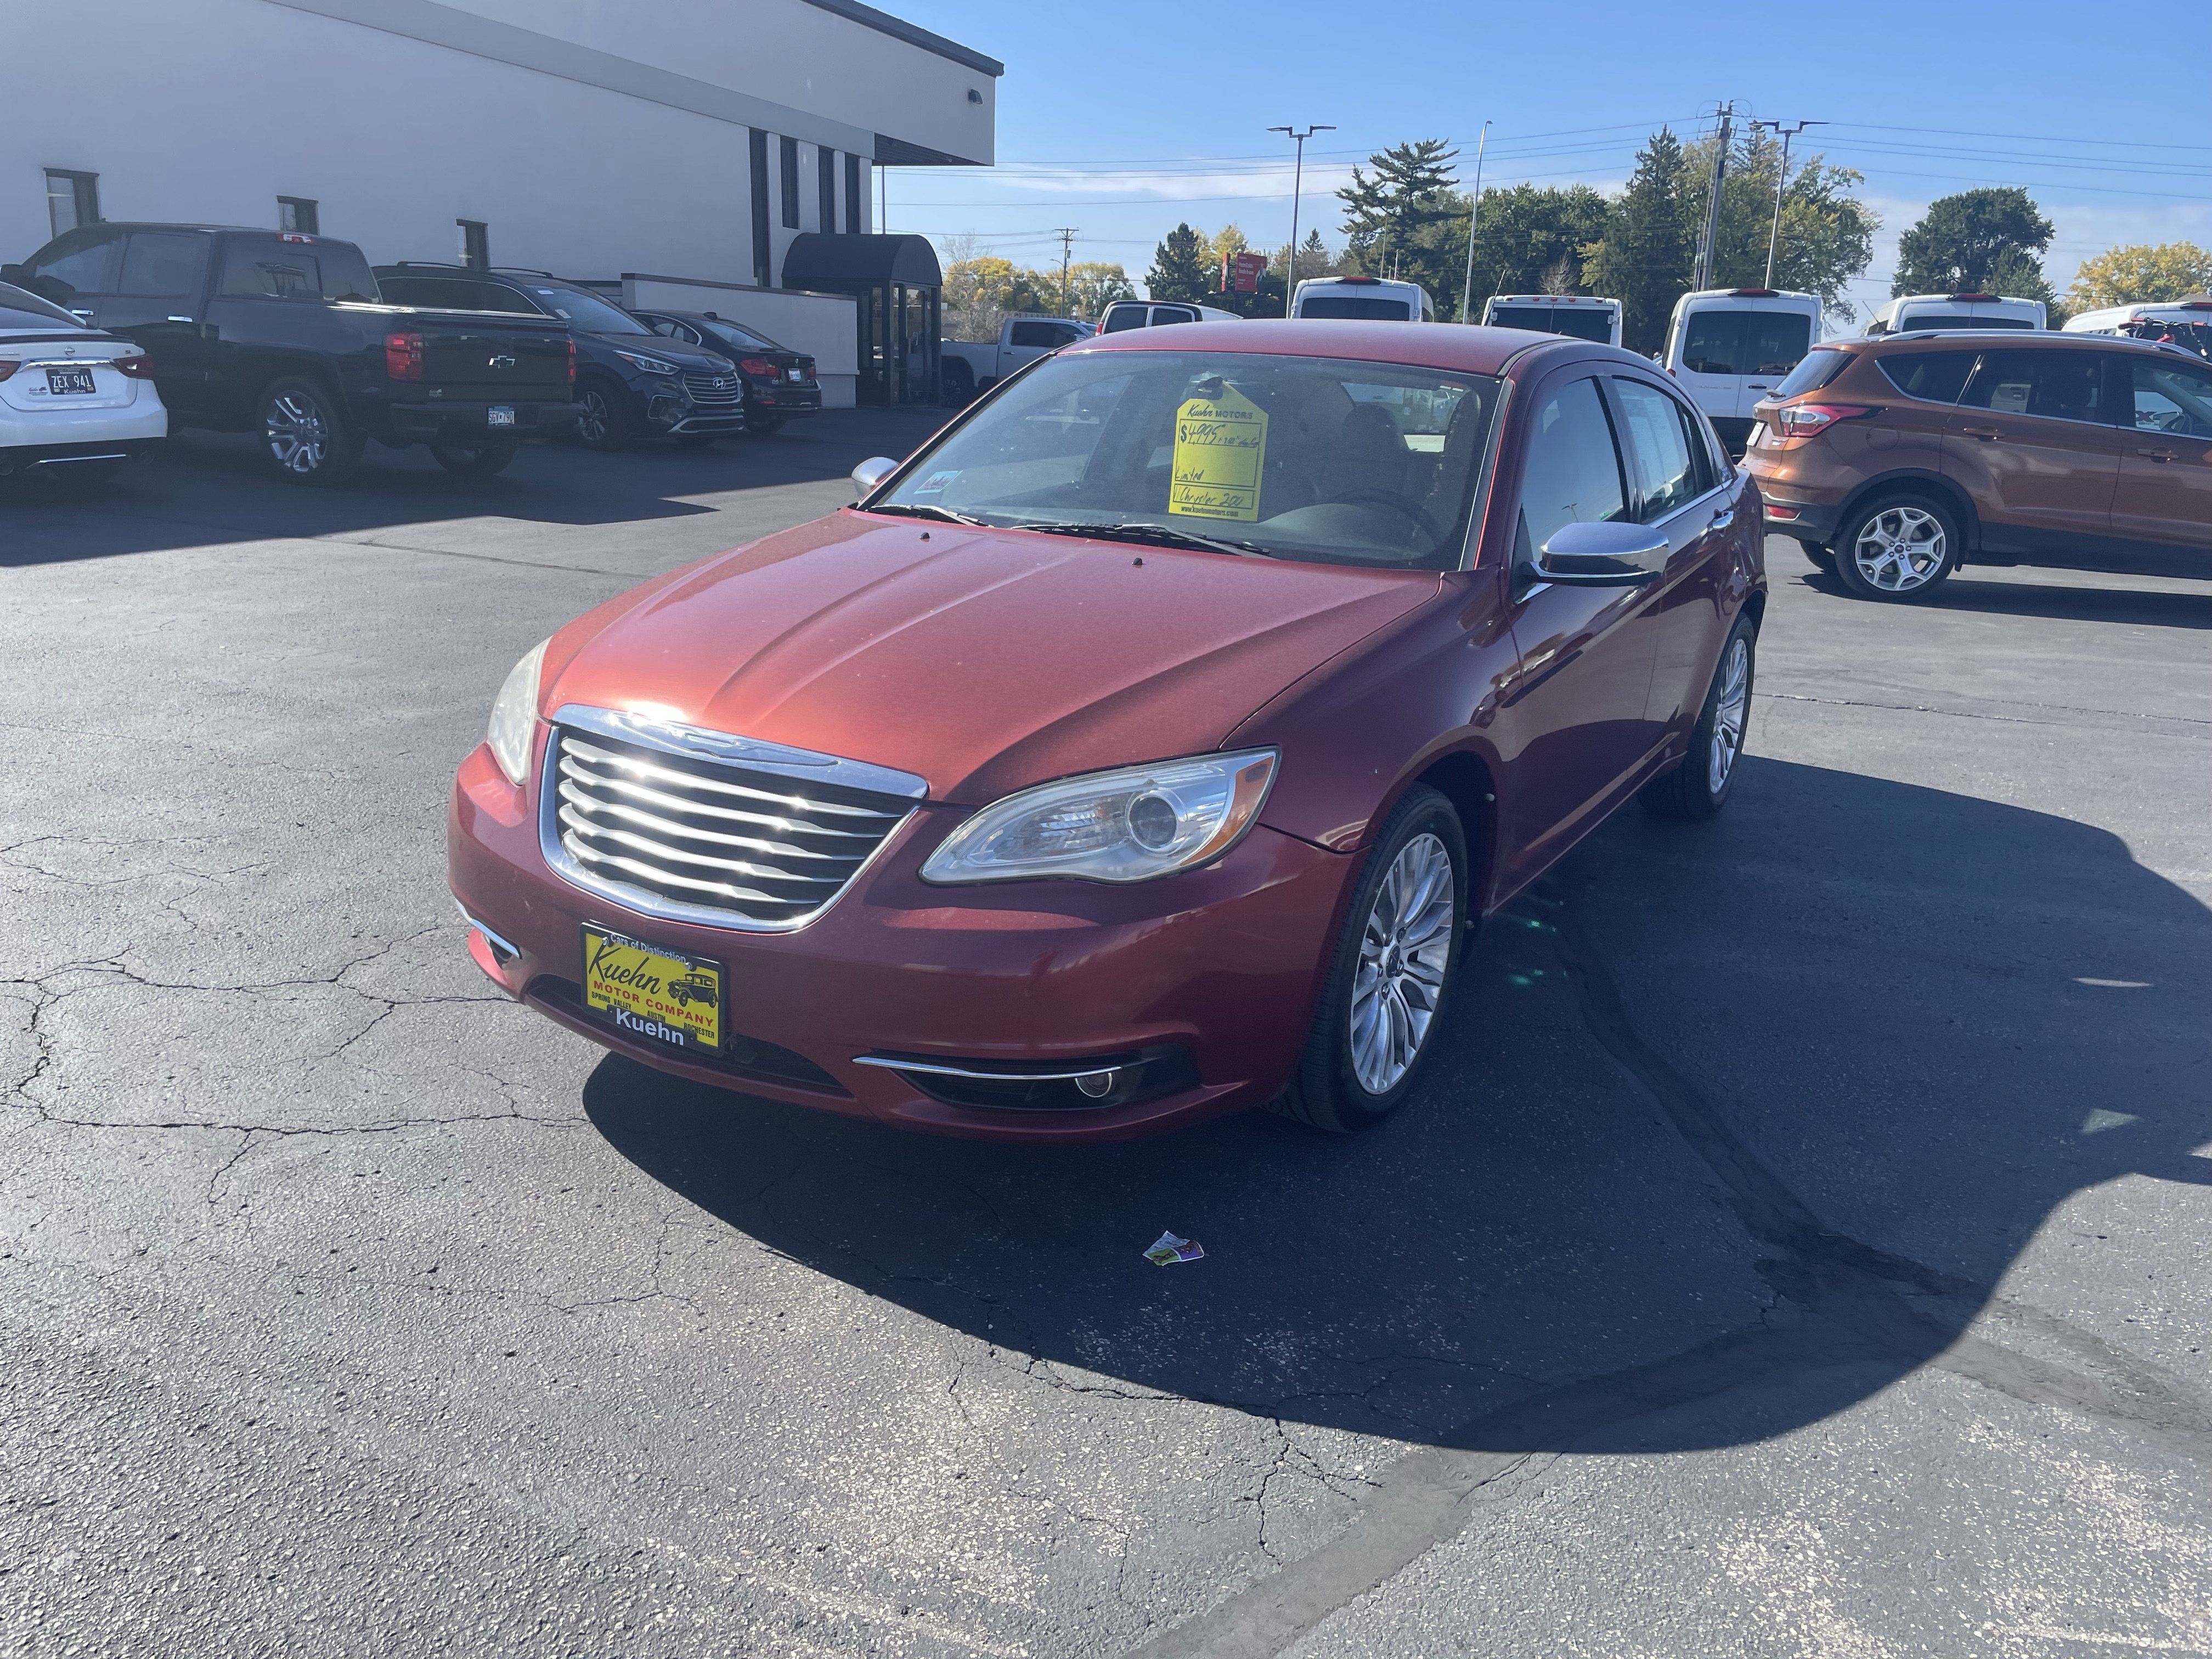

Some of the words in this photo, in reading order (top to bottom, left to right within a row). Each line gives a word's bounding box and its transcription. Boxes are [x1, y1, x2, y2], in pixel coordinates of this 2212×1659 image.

[51, 375, 70, 388] ZEX
[74, 375, 92, 387] 941
[489, 412, 499, 422] SGV
[503, 411, 513, 422] 790
[1187, 404, 1214, 418] Kuehn
[1215, 410, 1253, 420] MOTORS
[1180, 486, 1217, 506] Chrysler
[1220, 492, 1243, 507] 200
[610, 933, 629, 947] Cars
[630, 940, 639, 950] of
[641, 943, 686, 963] Distinction
[589, 943, 661, 995] Kuehn
[591, 991, 611, 1003] SPRING
[613, 999, 632, 1010] VALLEY
[593, 980, 640, 1003] MOTOR
[646, 998, 714, 1027] COMPANY
[647, 1010, 666, 1023] AUSTIN
[616, 1008, 684, 1046] Kuehn
[684, 1022, 715, 1039] ROCHESTER
